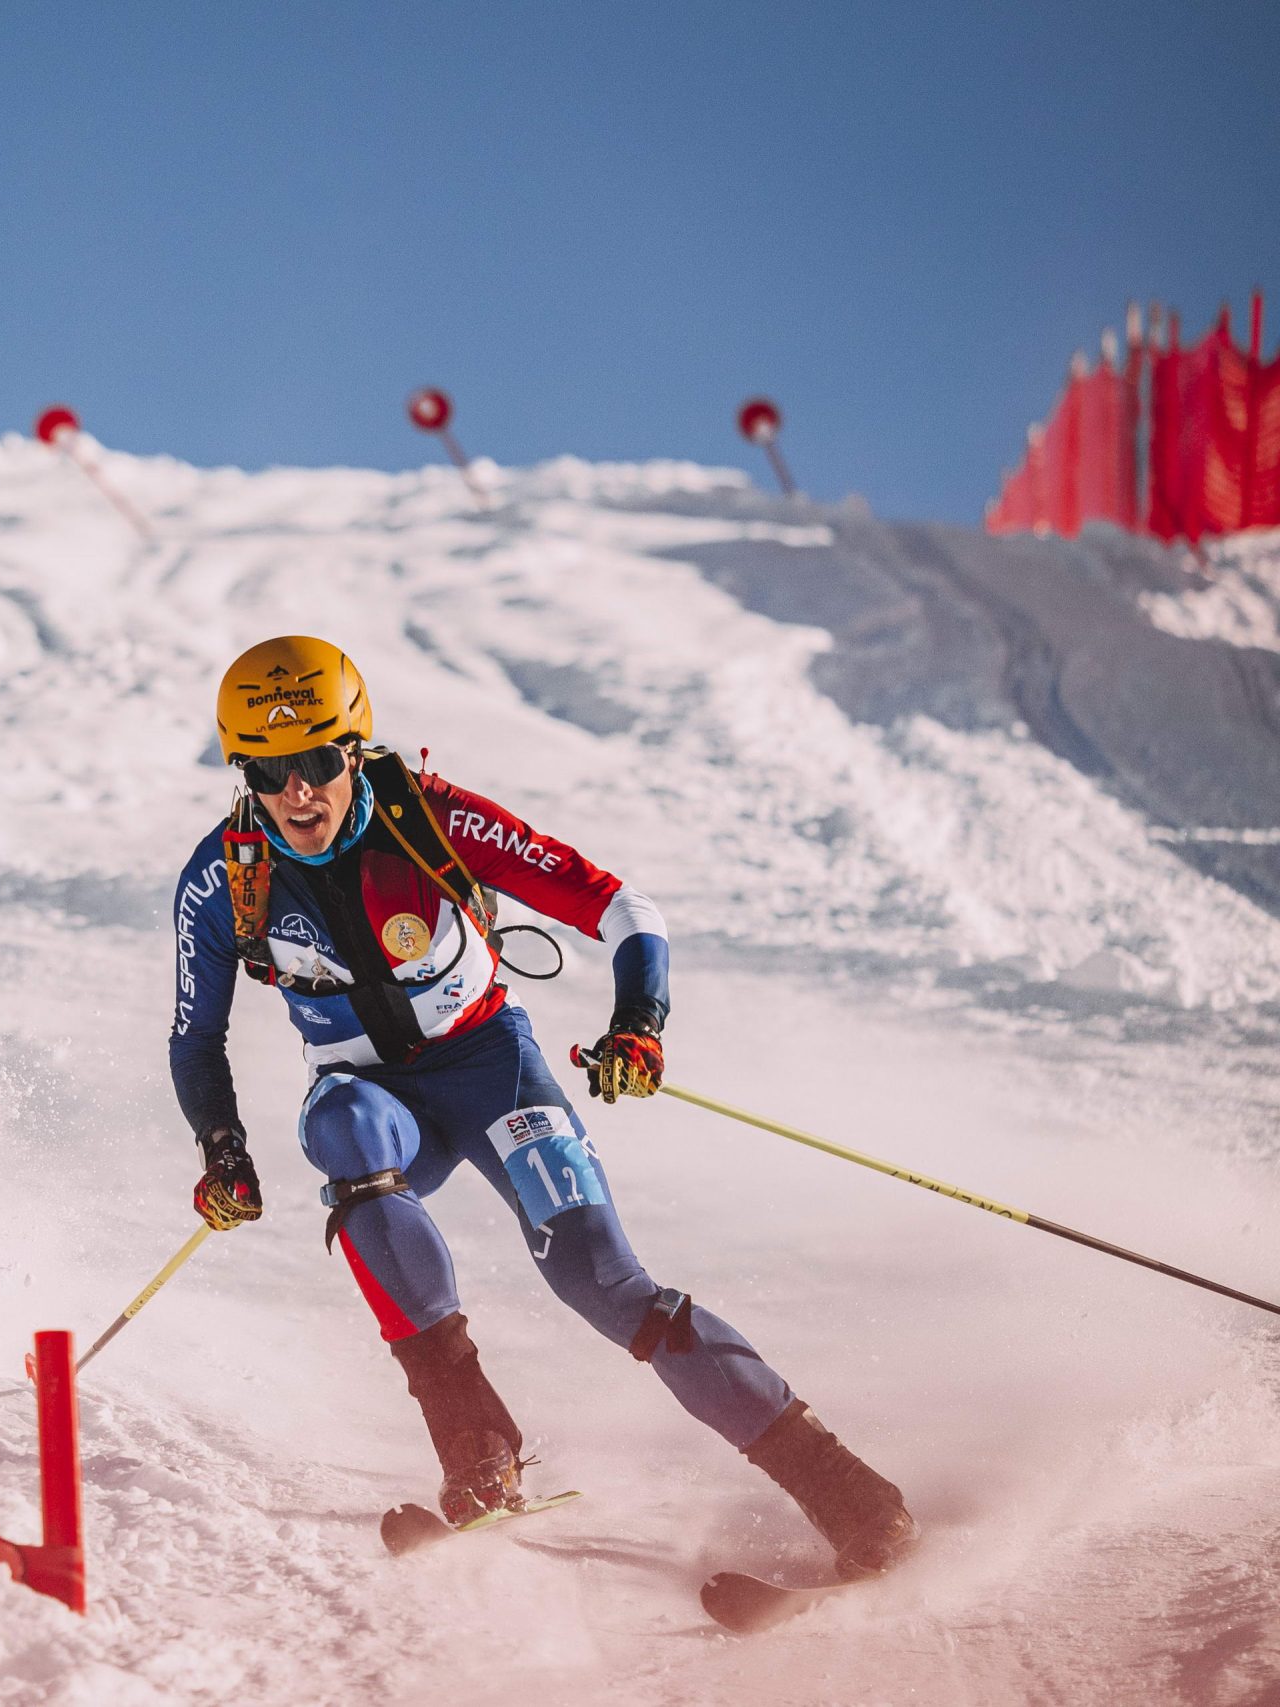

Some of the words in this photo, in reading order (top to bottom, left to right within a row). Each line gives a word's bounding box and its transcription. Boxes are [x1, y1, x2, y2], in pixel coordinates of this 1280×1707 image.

[247, 687, 315, 709] Bonneval
[289, 699, 307, 707] sur
[309, 697, 324, 706] Arc
[449, 809, 561, 873] FRANCE
[178, 858, 227, 999] SPORTIVA
[208, 1183, 257, 1221] SPORTIVA
